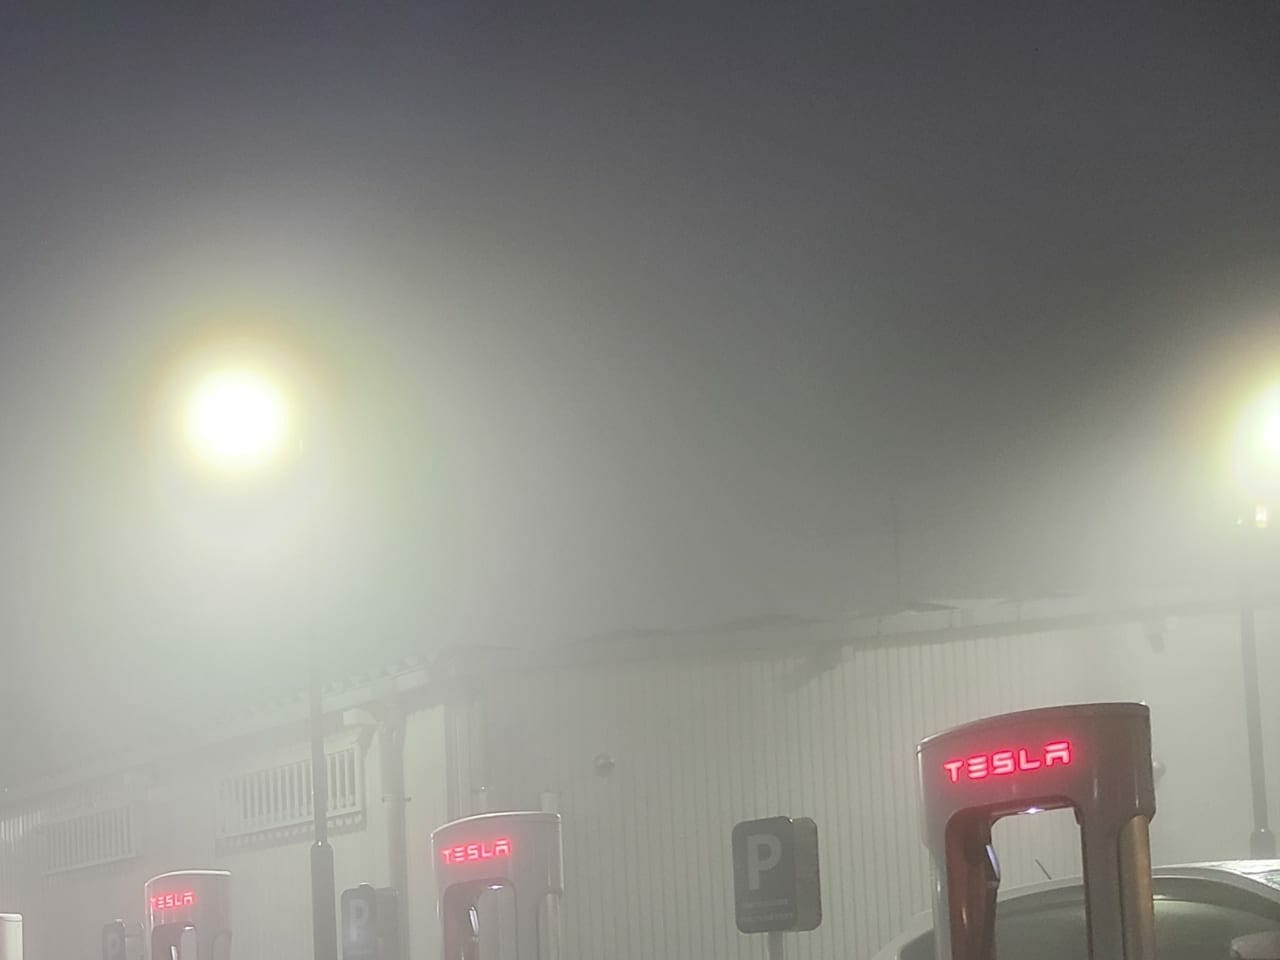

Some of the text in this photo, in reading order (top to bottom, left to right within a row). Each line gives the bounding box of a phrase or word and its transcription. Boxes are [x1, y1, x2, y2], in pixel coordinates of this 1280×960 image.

[943, 741, 1070, 782] TESLA
[442, 839, 510, 864] TESLA
[747, 833, 782, 890] P
[150, 891, 193, 908] TESLA
